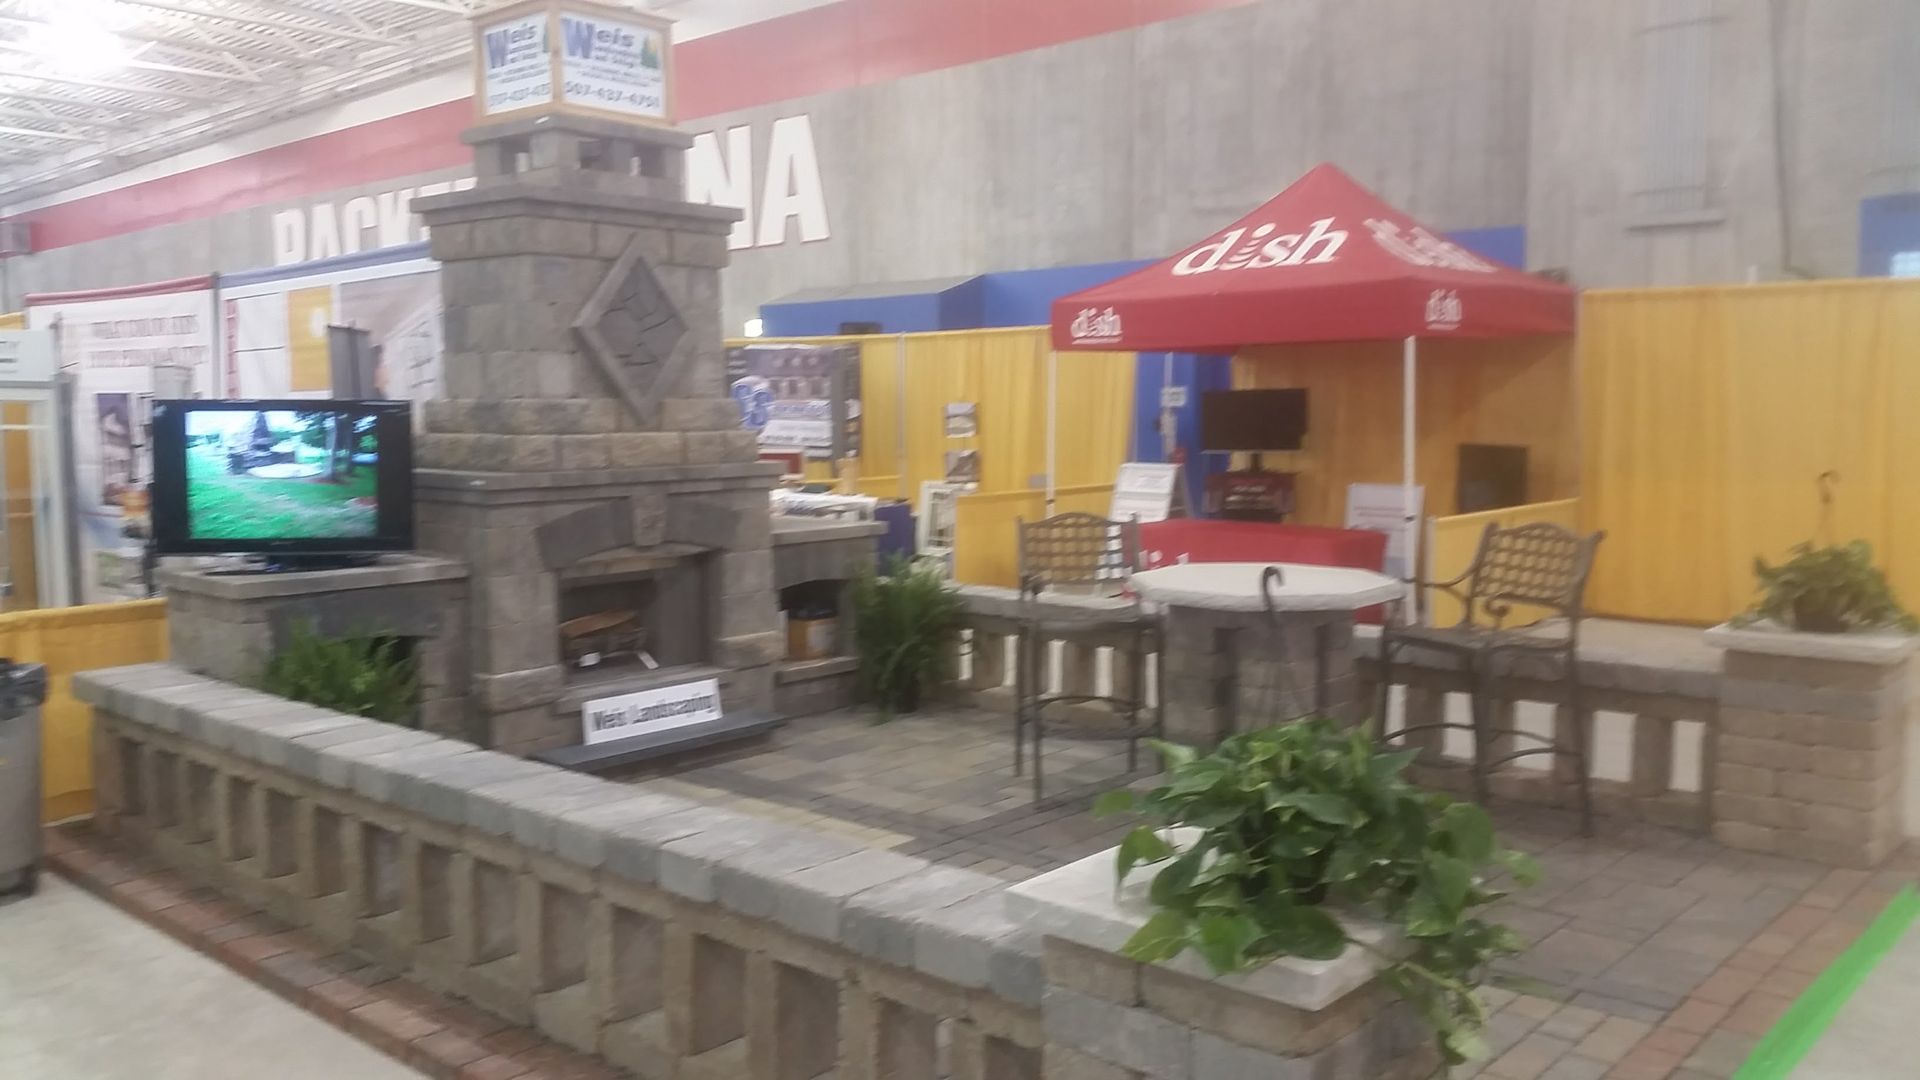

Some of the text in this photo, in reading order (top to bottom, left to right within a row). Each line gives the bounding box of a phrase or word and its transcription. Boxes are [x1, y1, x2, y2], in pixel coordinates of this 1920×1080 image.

[560, 17, 636, 59] Weis
[273, 177, 478, 266] PACK
[1170, 216, 1350, 277] dish
[1071, 305, 1123, 339] dish
